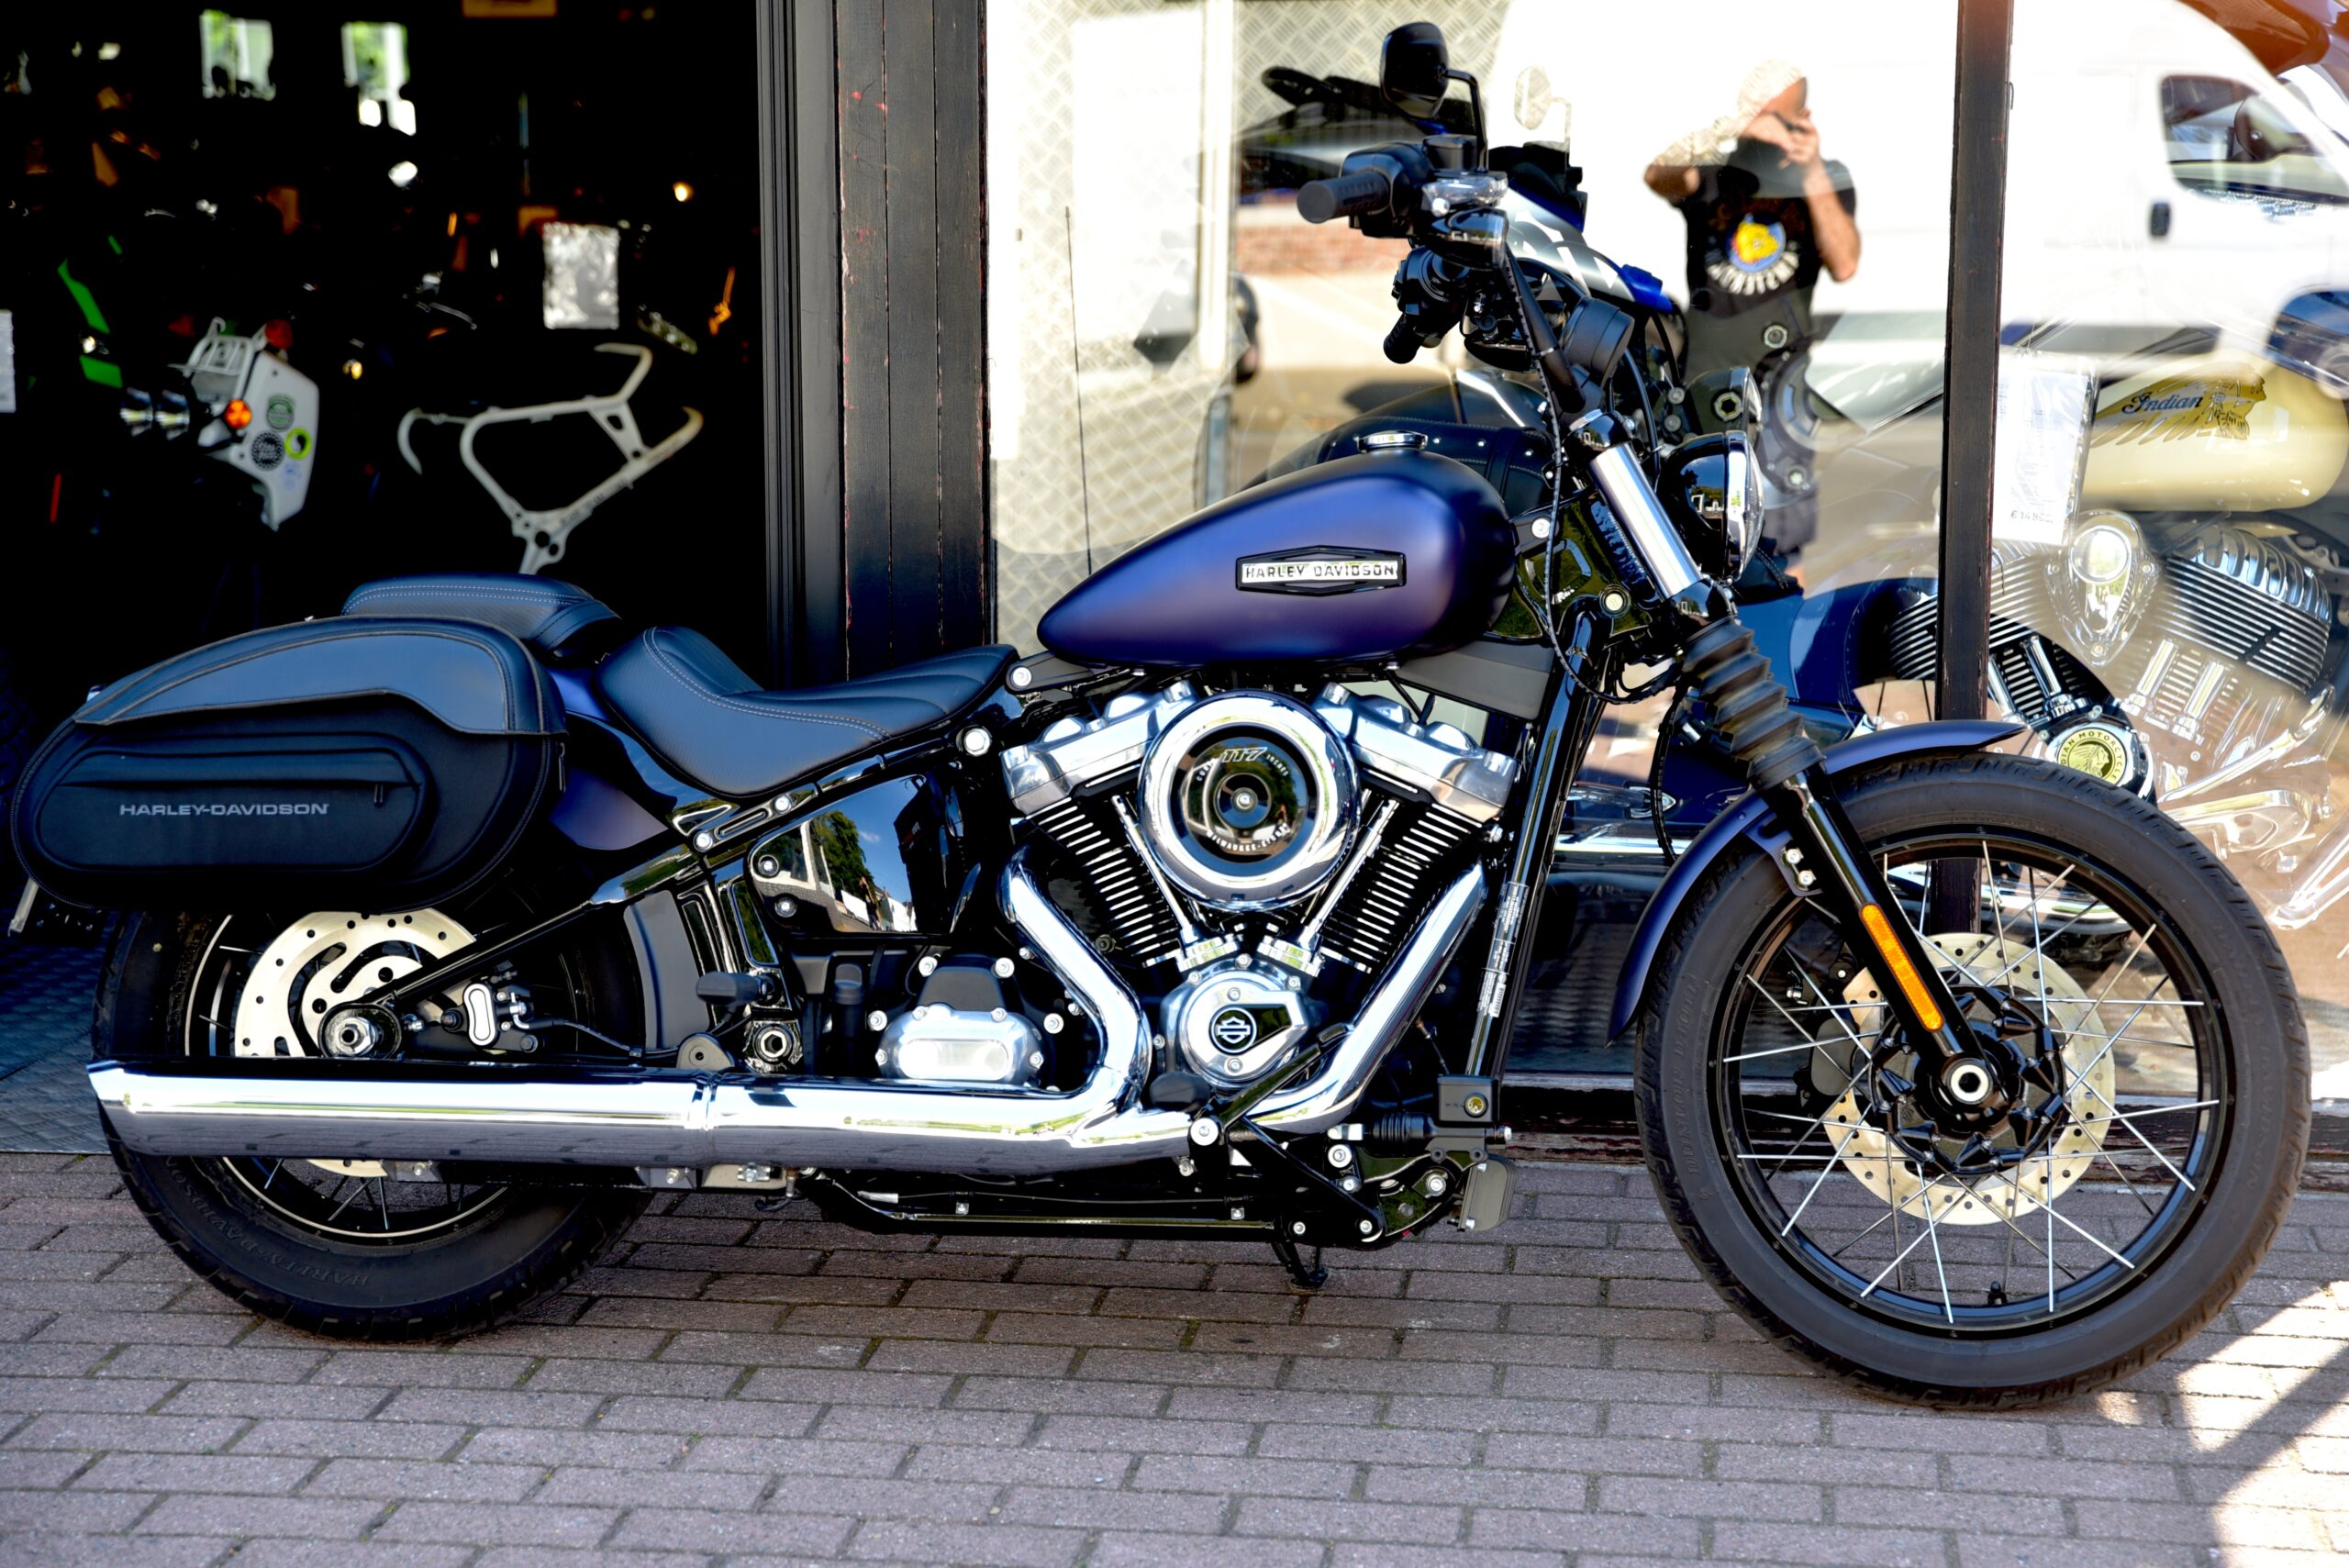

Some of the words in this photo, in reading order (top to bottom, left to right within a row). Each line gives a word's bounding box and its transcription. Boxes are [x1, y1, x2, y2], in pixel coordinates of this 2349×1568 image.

[2121, 392, 2204, 414] Indian
[1245, 564, 1305, 579] HARLEY
[1313, 563, 1395, 578] DAVIDSON
[1221, 747, 1268, 762] 117
[1266, 753, 1289, 777] INCHES
[2060, 739, 2076, 765] DIAN
[2078, 730, 2124, 780] MOTORCYCLE
[119, 803, 329, 816] HARLEY-DAVIDSON
